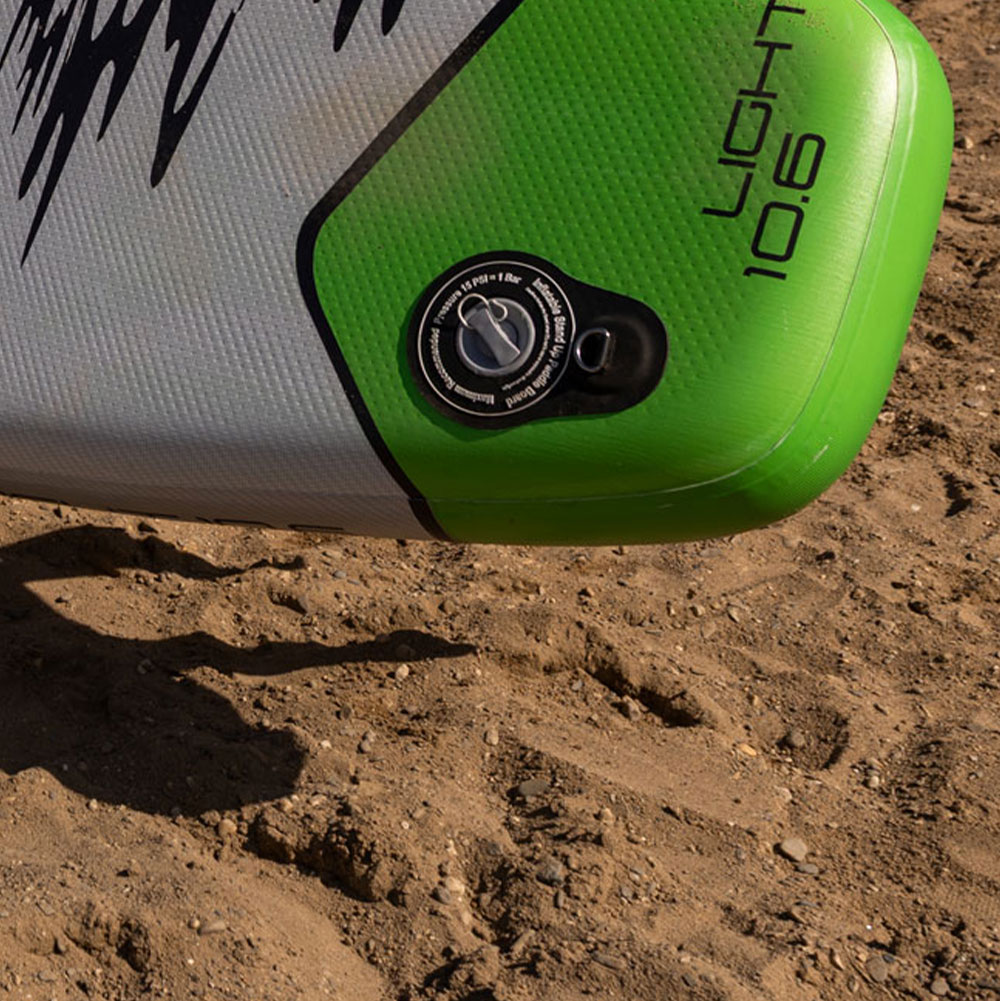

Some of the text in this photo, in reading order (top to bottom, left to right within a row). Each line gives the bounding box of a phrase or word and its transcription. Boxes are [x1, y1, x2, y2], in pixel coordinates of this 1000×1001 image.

[743, 132, 826, 280] 10.6
[460, 280, 473, 292] 15
[471, 273, 489, 287] PSI
[498, 272, 504, 282] 1
[504, 272, 522, 285] Bar
[433, 290, 462, 325] Pressure
[532, 277, 562, 315] Inflatable
[553, 315, 566, 344] Stand
[429, 327, 456, 390] Recommended
[549, 344, 565, 359] Up
[532, 358, 559, 388] Paddle
[454, 384, 494, 405] Maximum
[505, 385, 536, 409] Board
